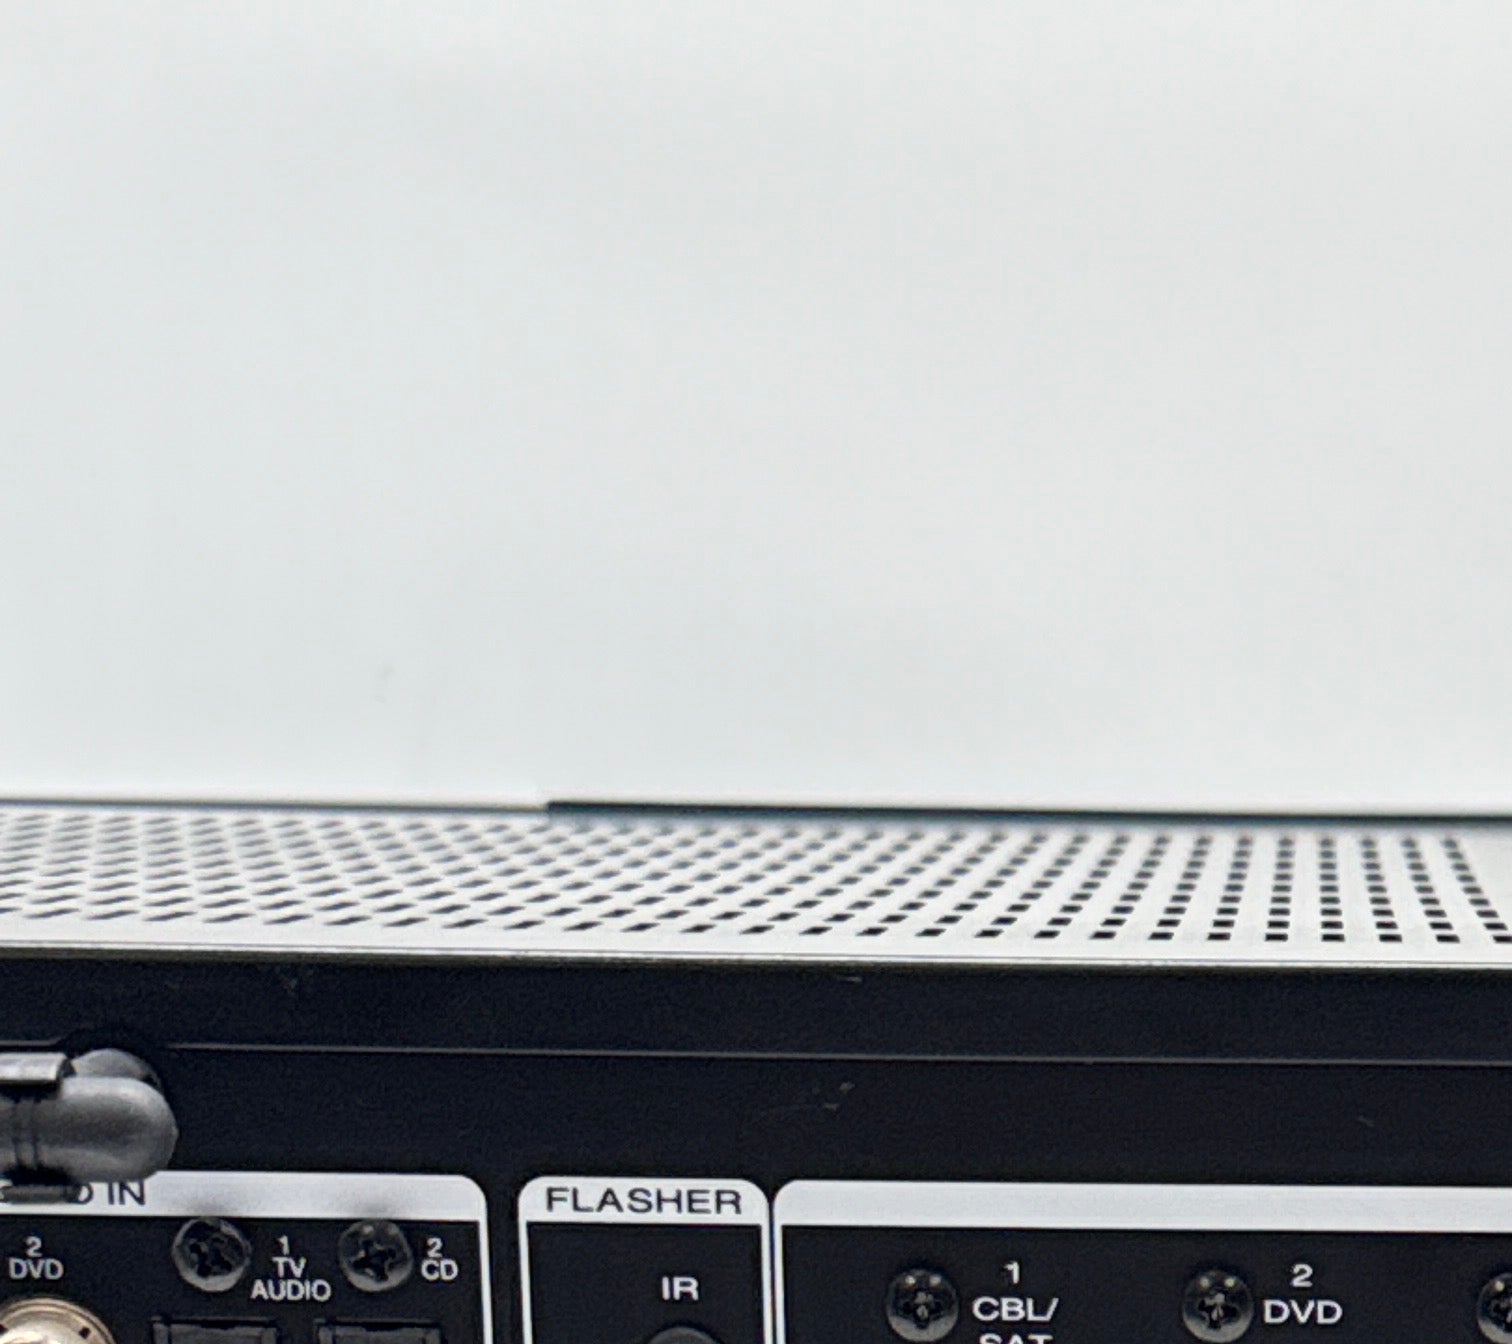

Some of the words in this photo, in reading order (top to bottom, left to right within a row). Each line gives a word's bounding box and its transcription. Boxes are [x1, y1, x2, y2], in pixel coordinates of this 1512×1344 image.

[545, 1186, 742, 1215] FLASHER
[25, 1235, 42, 1258] 2
[278, 1235, 290, 1255] 1
[427, 1237, 443, 1258] 2
[8, 1257, 64, 1280] DVD
[272, 1256, 307, 1278] TV
[420, 1258, 459, 1281] CD
[1005, 1261, 1020, 1284] 1
[1291, 1263, 1313, 1288] 2
[250, 1278, 332, 1302] AUDIO
[661, 1276, 699, 1300] IR
[972, 1296, 1059, 1322] CBL/
[1263, 1299, 1343, 1324] DVD
